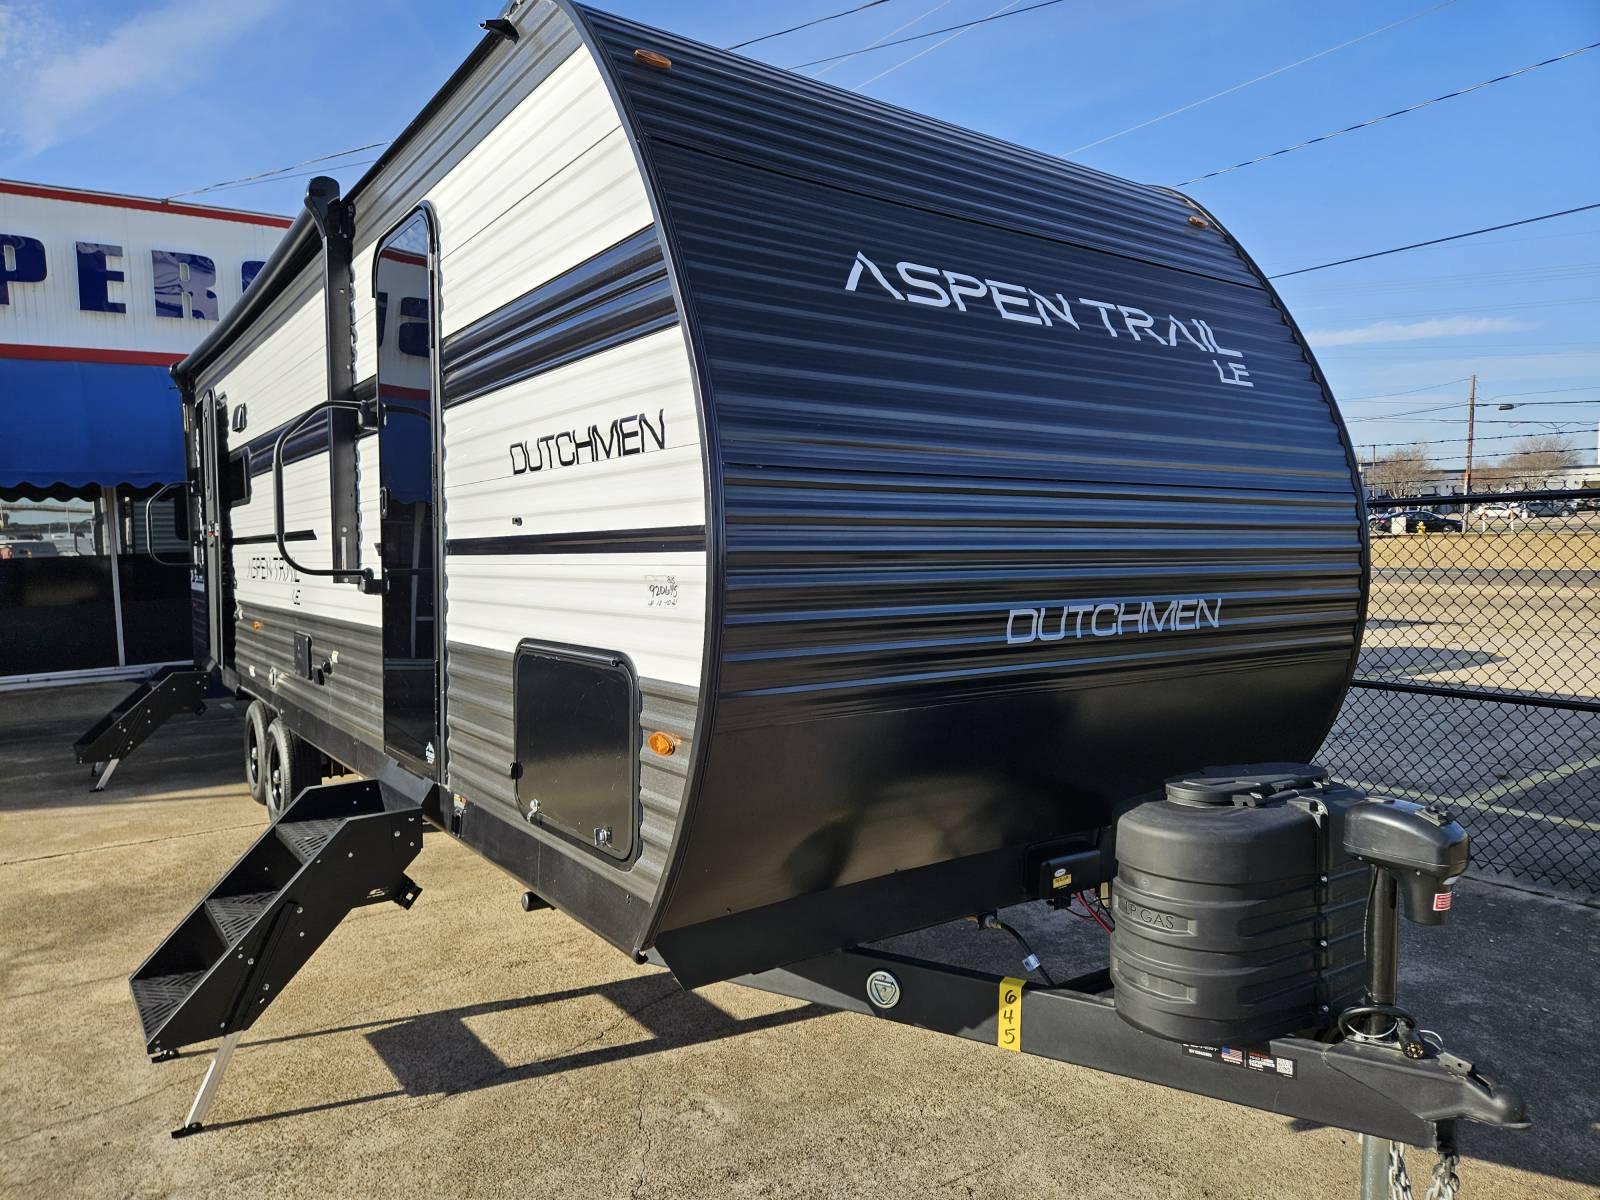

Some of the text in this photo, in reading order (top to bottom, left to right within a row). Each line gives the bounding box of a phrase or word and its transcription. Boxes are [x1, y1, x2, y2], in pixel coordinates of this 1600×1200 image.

[0, 234, 267, 321] PER
[844, 250, 1243, 358] ASPEN TRAIL
[1212, 359, 1254, 388] LE
[509, 408, 666, 475] DUTCHMEN
[1006, 597, 1222, 645] DUTCHMEN
[1140, 908, 1174, 930] GAS
